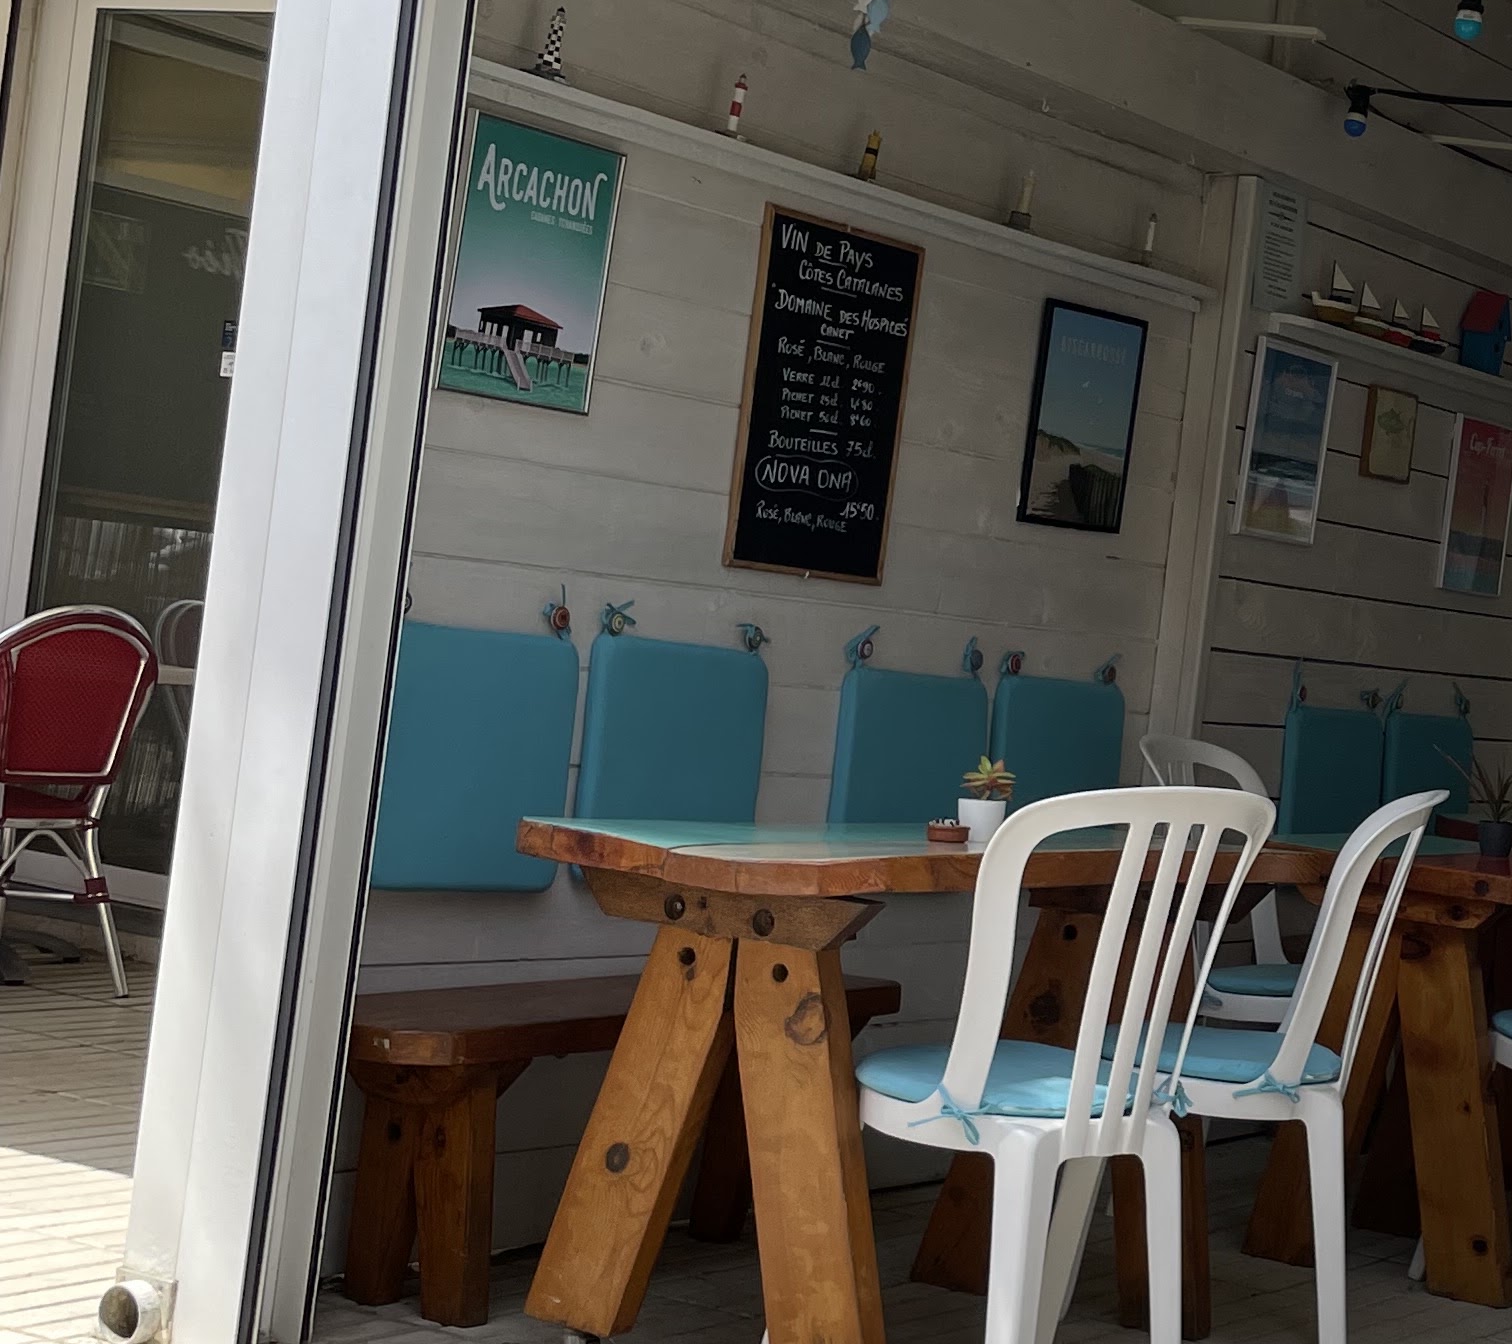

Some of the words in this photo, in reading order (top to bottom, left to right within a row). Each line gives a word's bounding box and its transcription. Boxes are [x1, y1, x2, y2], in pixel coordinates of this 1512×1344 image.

[477, 143, 608, 221] ARCACHON
[782, 223, 810, 253] VIN
[814, 241, 833, 260] DE
[839, 241, 873, 273] PAYS
[799, 259, 834, 285] CÔTES
[836, 269, 904, 302] CATALANES
[774, 288, 833, 321] DOMAINE
[839, 310, 860, 325] DES
[820, 323, 854, 340] CANET
[782, 366, 816, 384] VERRE
[853, 354, 886, 373] ROUGE
[767, 429, 839, 455] BOUTEILLES
[761, 459, 810, 486] NOVA
[817, 469, 852, 493] ONA
